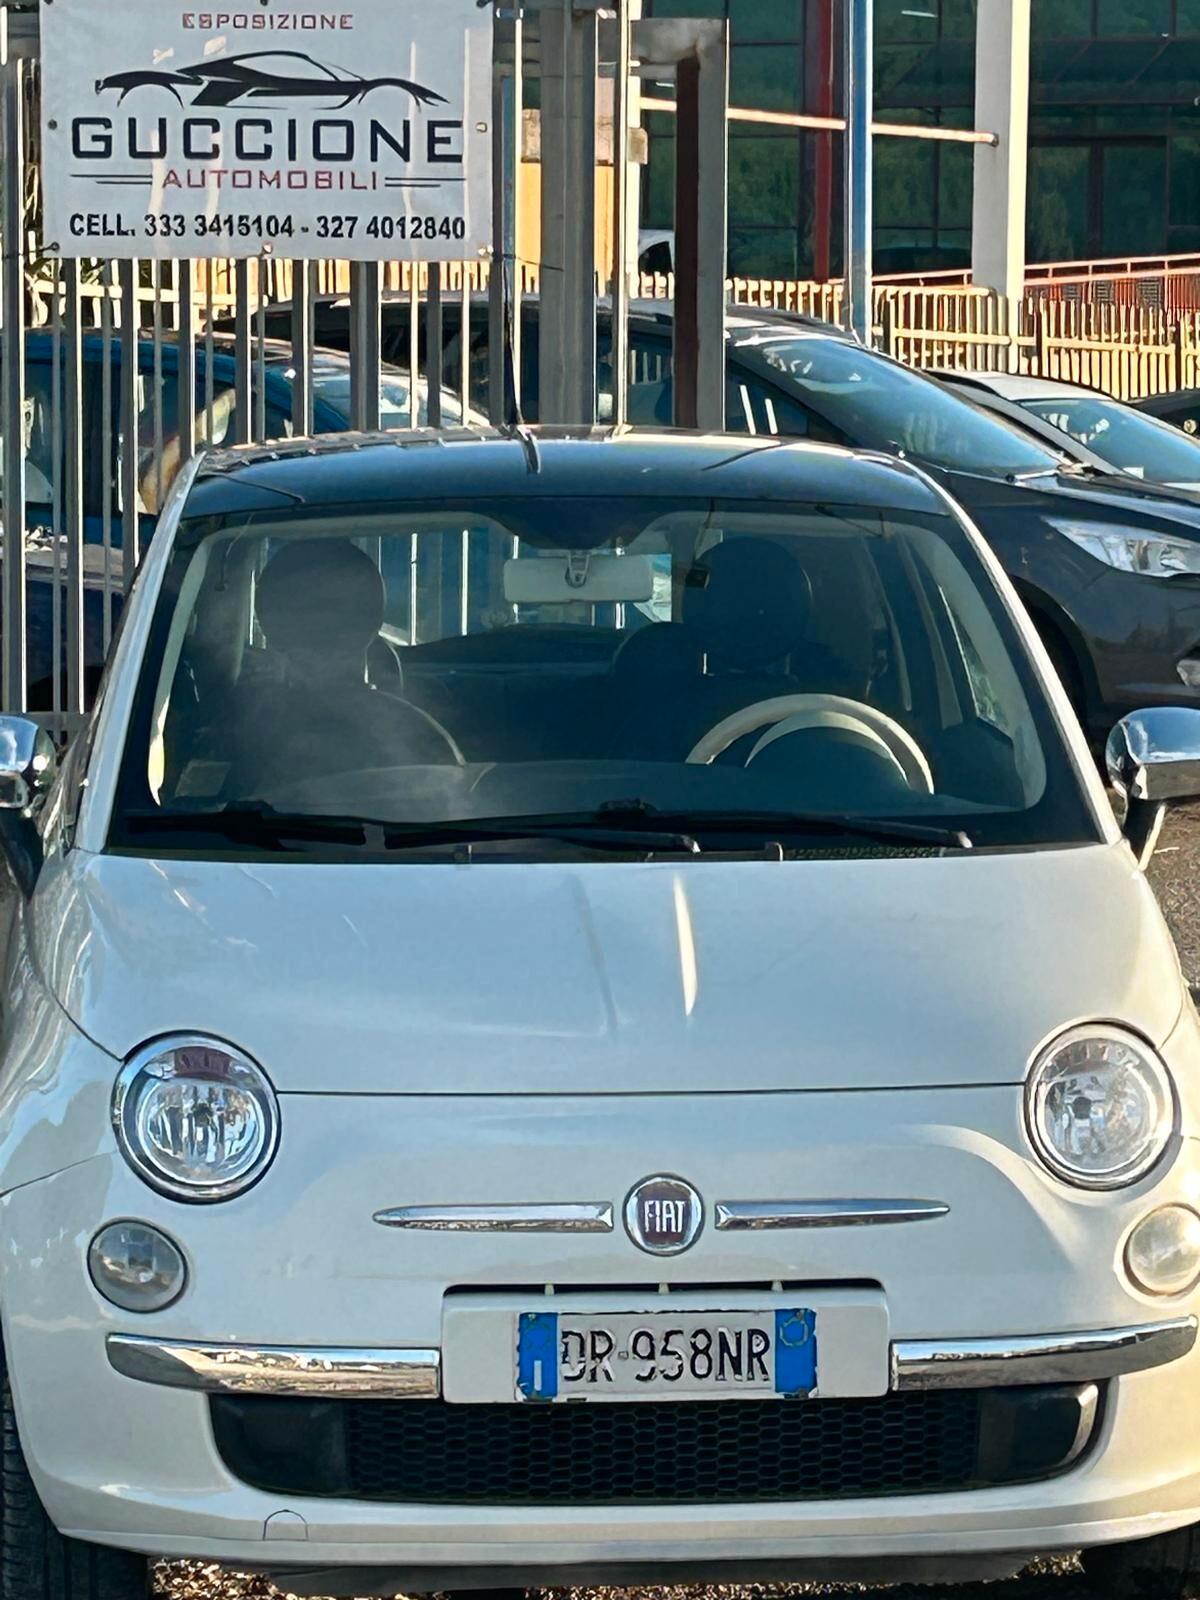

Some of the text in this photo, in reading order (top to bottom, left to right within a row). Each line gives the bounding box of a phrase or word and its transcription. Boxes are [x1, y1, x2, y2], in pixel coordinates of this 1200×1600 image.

[182, 13, 353, 30] ESPOSIZIONE
[71, 116, 463, 163] GUCCIONE
[162, 169, 378, 190] AUTOMOBILI
[69, 213, 136, 237] CELL.
[144, 213, 186, 238] 333
[194, 214, 293, 238] 3415104
[316, 215, 356, 239] 327
[366, 216, 466, 240] 4012840
[643, 1200, 685, 1233] FIAT
